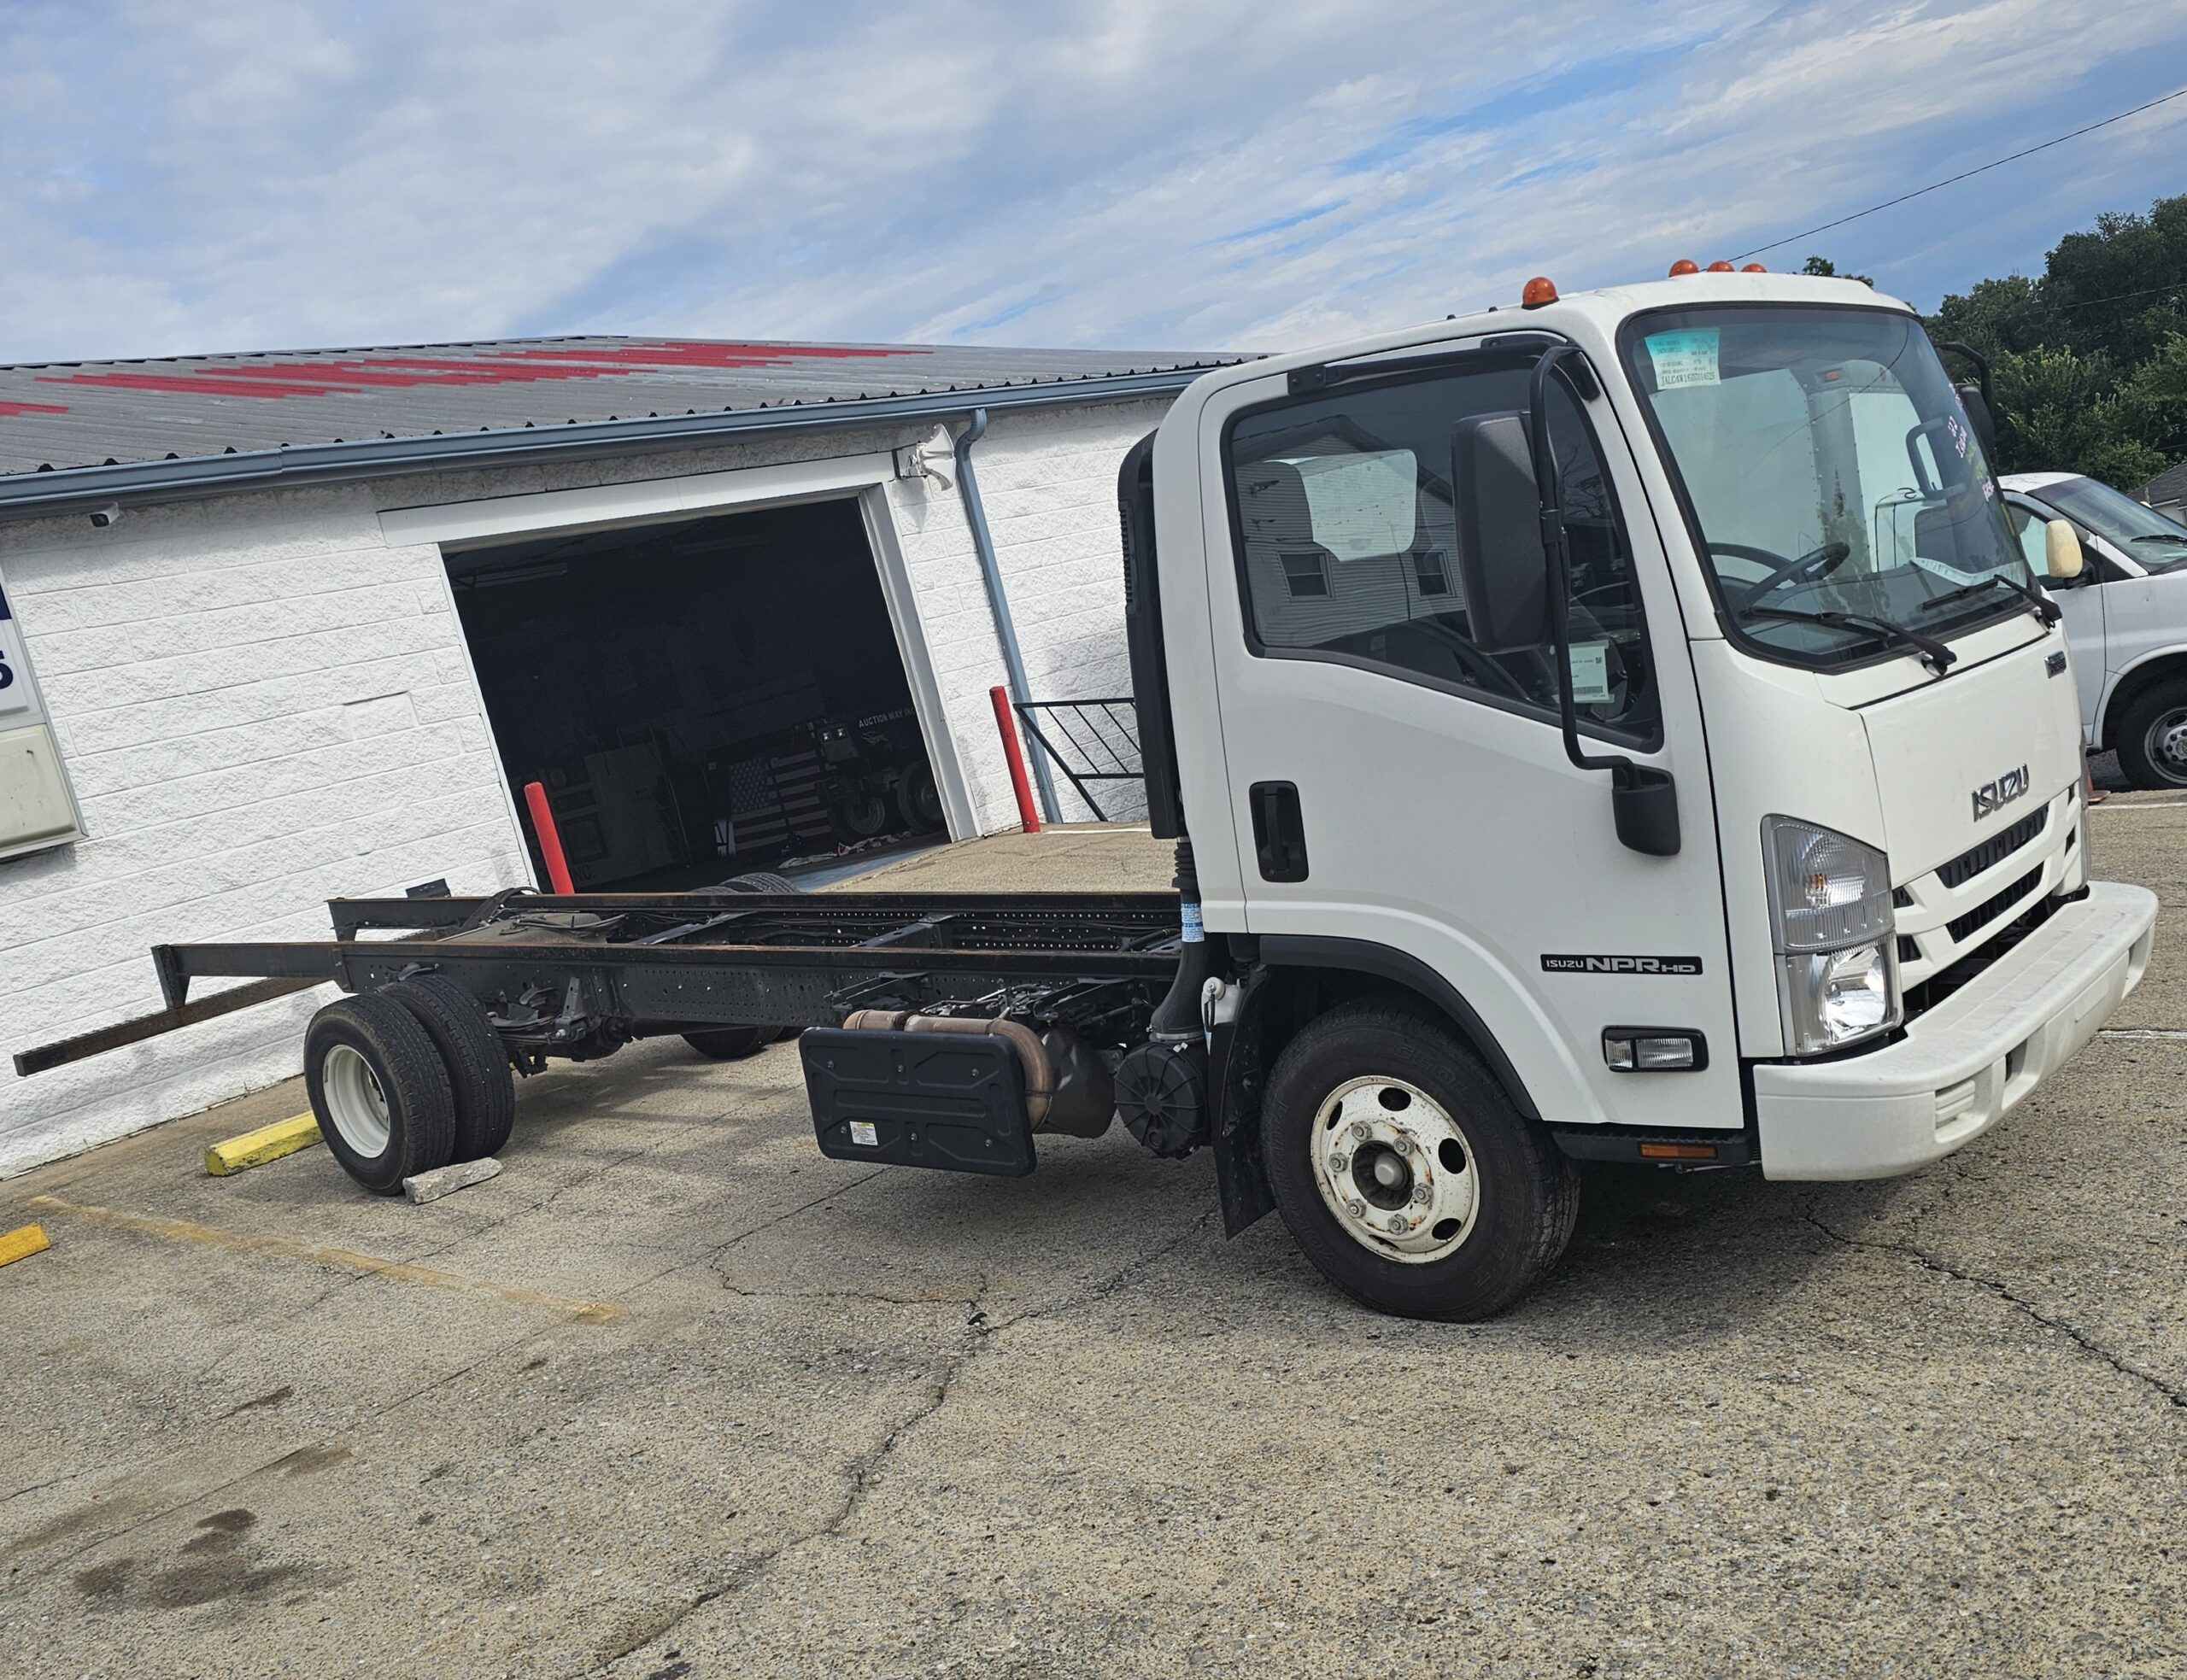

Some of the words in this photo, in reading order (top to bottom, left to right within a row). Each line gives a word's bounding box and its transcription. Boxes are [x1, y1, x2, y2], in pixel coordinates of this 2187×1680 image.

[859, 713, 888, 728] AUCTION
[888, 709, 903, 721] WAY
[1972, 763, 2030, 823] ISUZU
[1545, 959, 1584, 969] ISUZU
[1586, 957, 1661, 973] NPR
